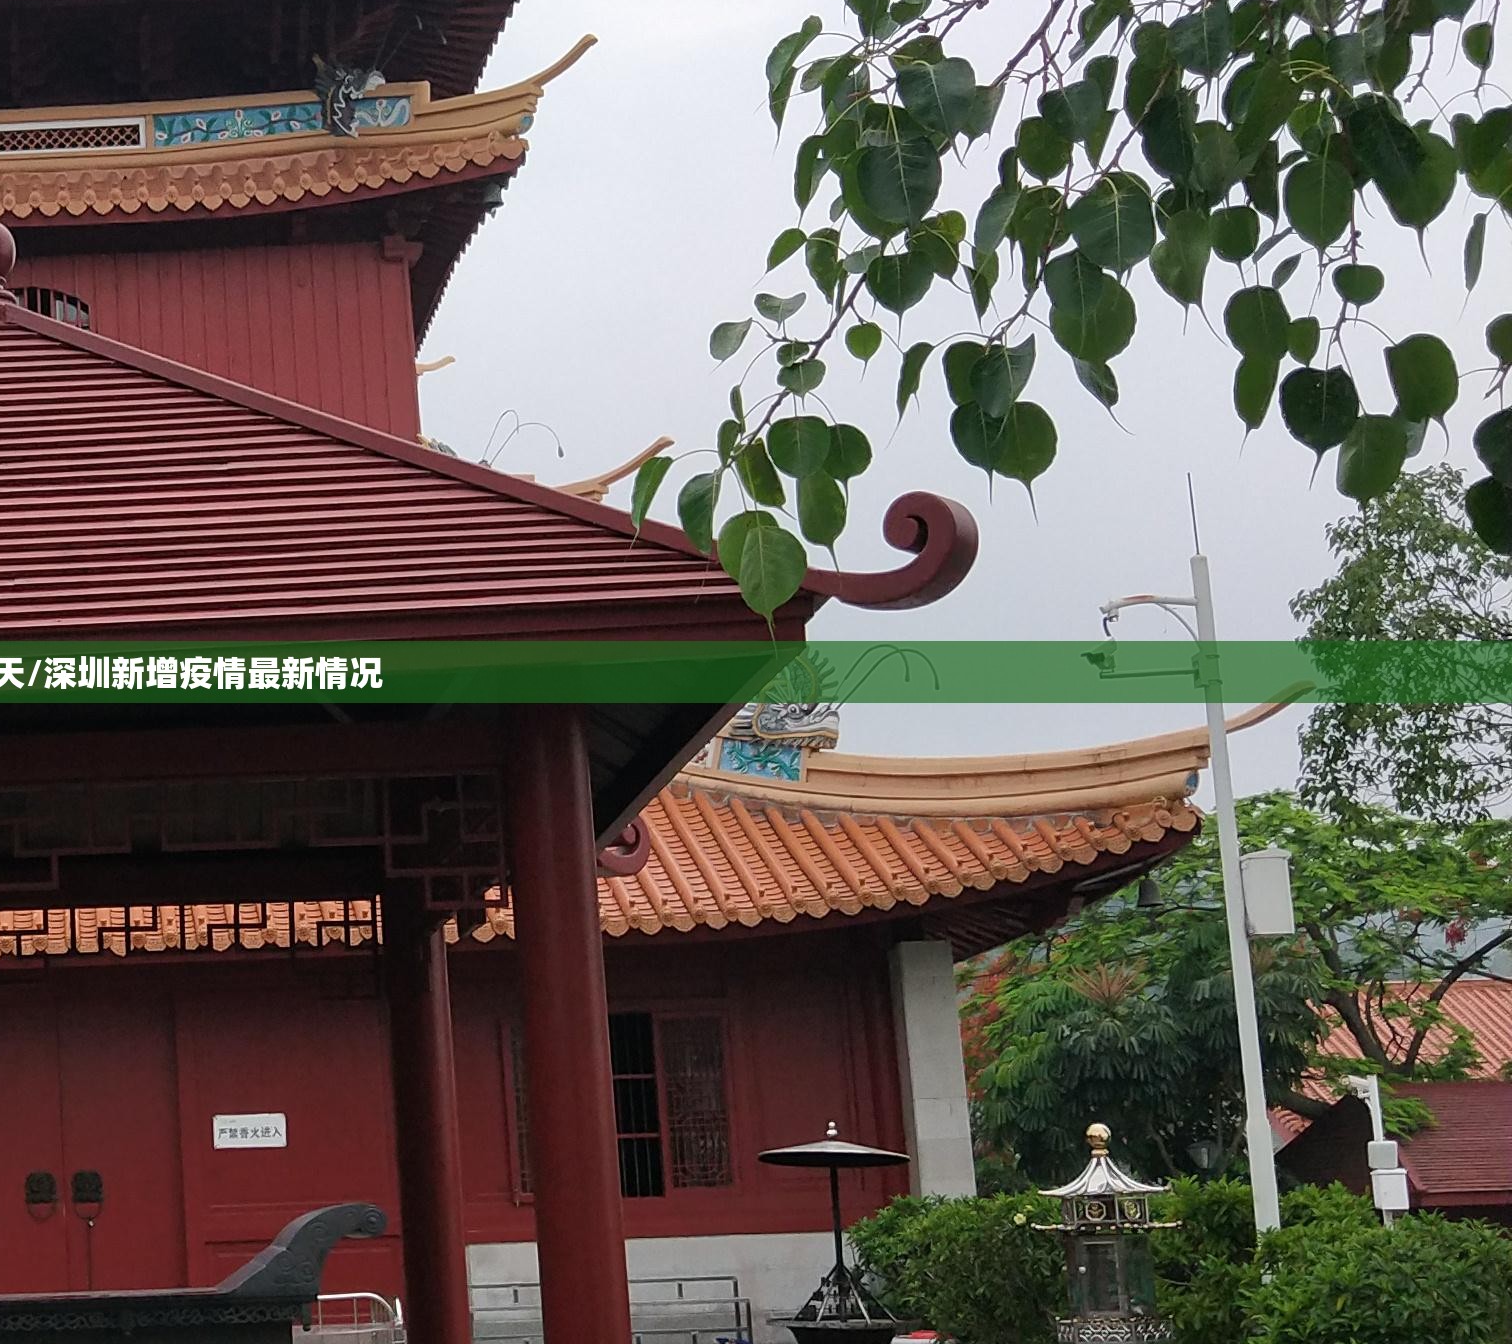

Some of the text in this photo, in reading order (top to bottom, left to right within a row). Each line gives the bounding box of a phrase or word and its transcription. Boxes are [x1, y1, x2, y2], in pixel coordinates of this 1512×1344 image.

[218, 1126, 283, 1140] 严禁香火进入
